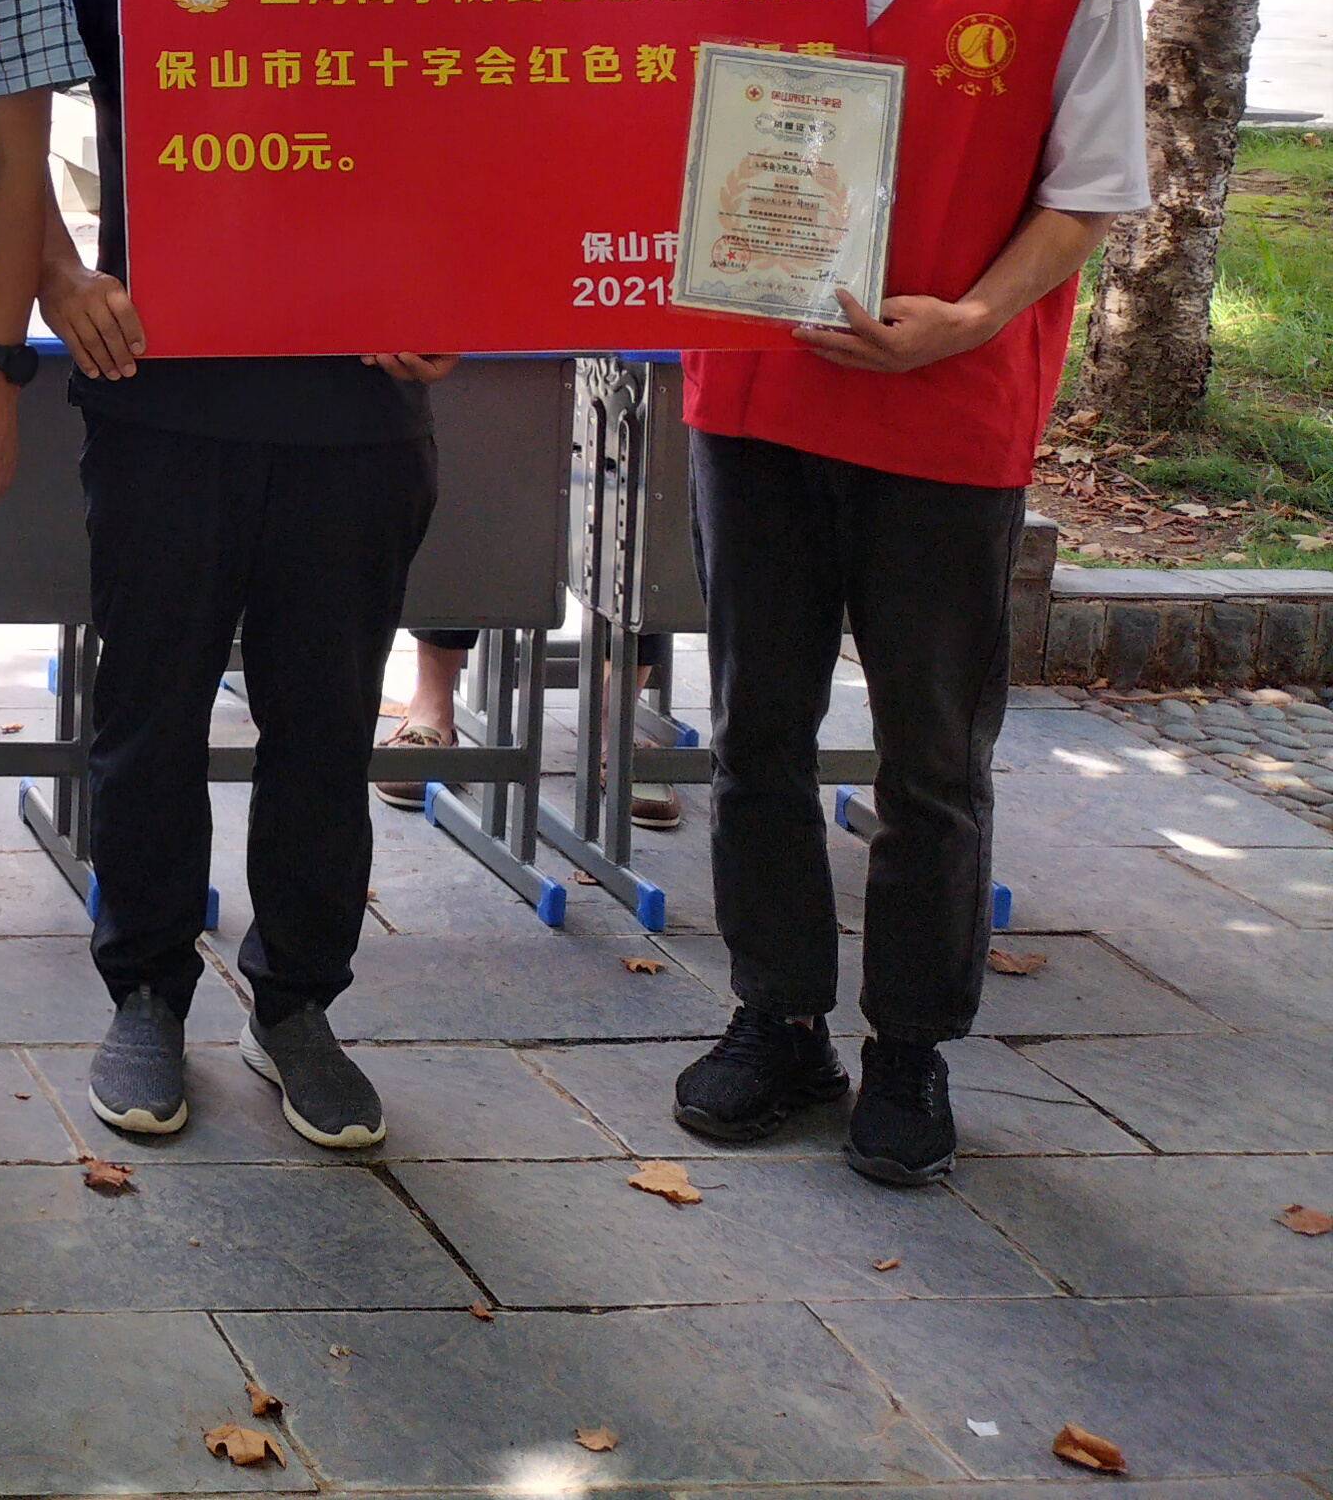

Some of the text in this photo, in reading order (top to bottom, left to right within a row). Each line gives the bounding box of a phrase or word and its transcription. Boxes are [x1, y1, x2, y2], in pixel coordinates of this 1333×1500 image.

[155, 42, 836, 90] 保山市红十字会红色教
[157, 131, 355, 173] 4000元。
[581, 232, 679, 263] 保山市
[572, 276, 675, 307] 2021
